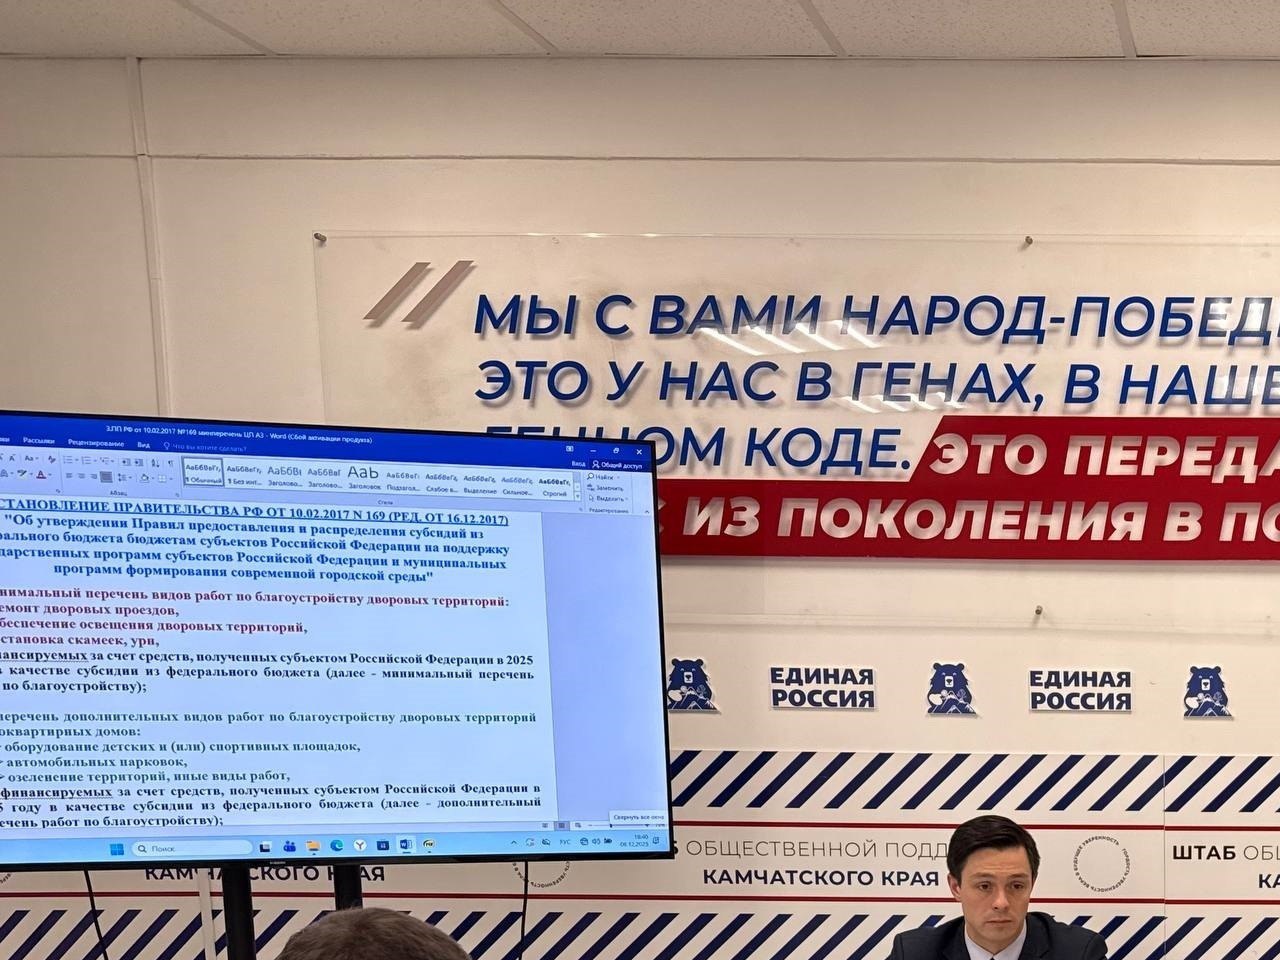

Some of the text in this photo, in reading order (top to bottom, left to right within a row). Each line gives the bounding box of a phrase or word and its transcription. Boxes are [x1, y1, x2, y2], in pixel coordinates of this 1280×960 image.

[474, 295, 577, 335] МЫ
[595, 295, 634, 336] С
[648, 295, 821, 336] ВАМИ
[475, 360, 589, 401] ЭТО
[605, 362, 645, 401] У
[659, 361, 779, 401] НАС
[797, 362, 831, 401] В
[852, 362, 1044, 411] ГЕНАХ,
[1065, 364, 1100, 404] В
[745, 427, 909, 475] КОДЕ.
[931, 433, 1047, 475] ЭТО
[0, 498, 509, 525] СТАНОВЛЕНИЕ ПРАВИТЕЛЬСТВА РФ ОТ 10.02.2017 N 169 (РЕД. ОТ 16.12.2017)
[684, 498, 761, 537] ИЗ
[778, 498, 1149, 541] ПОКОЛЕНИЯ
[1164, 501, 1203, 541] В
[5, 514, 33, 525] "Об
[36, 518, 128, 531] утверждении
[132, 517, 184, 533] Правил
[188, 522, 295, 536] предоставления
[310, 525, 406, 539] распределения
[409, 525, 466, 540] субсидий
[54, 563, 433, 584] программ формирования современной городской среды"
[0, 586, 509, 609] нимальный перечень видов работ по благоустройству дворовых территорий:
[43, 605, 111, 618] дворовых
[114, 606, 179, 619] проездов,
[79, 621, 153, 632] освещения
[156, 622, 223, 634] дворовых
[226, 620, 307, 635] территорий,
[0, 636, 159, 649] становка скамеек, урн,
[9, 664, 534, 682] качестве субсидии из федерального бюджета (далее минимальный перечень
[771, 667, 873, 687] ЕДИНАЯ
[1031, 670, 1130, 690] ЕДИНАЯ
[773, 690, 874, 708] РОССИЯ
[1032, 692, 1131, 710] РОССИЯ
[63, 713, 178, 723] дополнительных
[184, 713, 222, 723] видов
[227, 710, 264, 724] работ
[289, 711, 395, 725] благоустройству
[399, 714, 460, 725] дворовых
[464, 711, 536, 725] территорий
[4, 741, 99, 754] оборудование
[102, 744, 155, 753] детских
[170, 741, 206, 754] (или)
[209, 744, 289, 754] спортивных
[292, 744, 360, 752] площадок,
[6, 755, 187, 769] автомобильных парковок,
[8, 770, 290, 784] озеленение территорий, иные виды работ,
[11, 803, 41, 815] году
[65, 803, 125, 811] качестве
[132, 799, 193, 814] субсидии
[201, 802, 215, 810] из
[222, 798, 312, 813] федерального
[318, 798, 373, 811] бюджета
[380, 798, 419, 811] (далее
[437, 797, 541, 810] дополнительный
[41, 815, 80, 829] работ
[102, 814, 223, 829] благоустройству);
[686, 840, 877, 858] ОБЩЕСТВЕННОЙ
[1172, 845, 1236, 860] ШТАБ
[703, 869, 939, 887] КАМЧАТСКОГО КРАЯ
